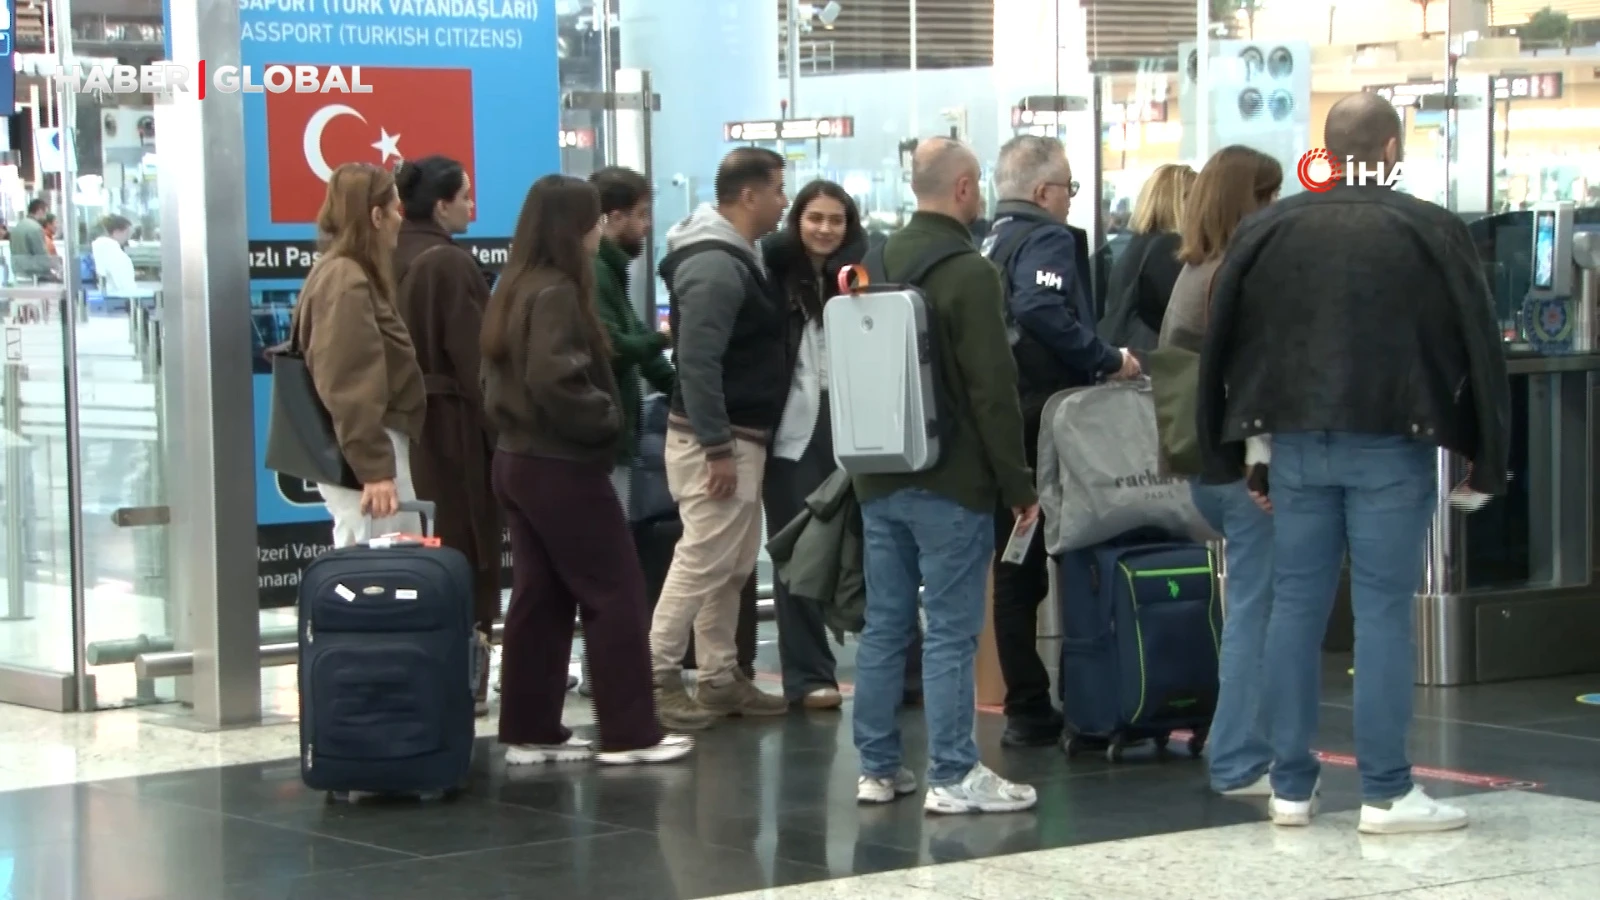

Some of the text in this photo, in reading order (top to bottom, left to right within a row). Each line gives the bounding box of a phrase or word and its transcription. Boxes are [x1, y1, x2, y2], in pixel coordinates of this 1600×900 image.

[389, 0, 538, 22] VATANDAŞLARI)
[240, 21, 522, 49] ASSPORT (TURKISH CITIZENS)
[1036, 270, 1062, 290] HH
